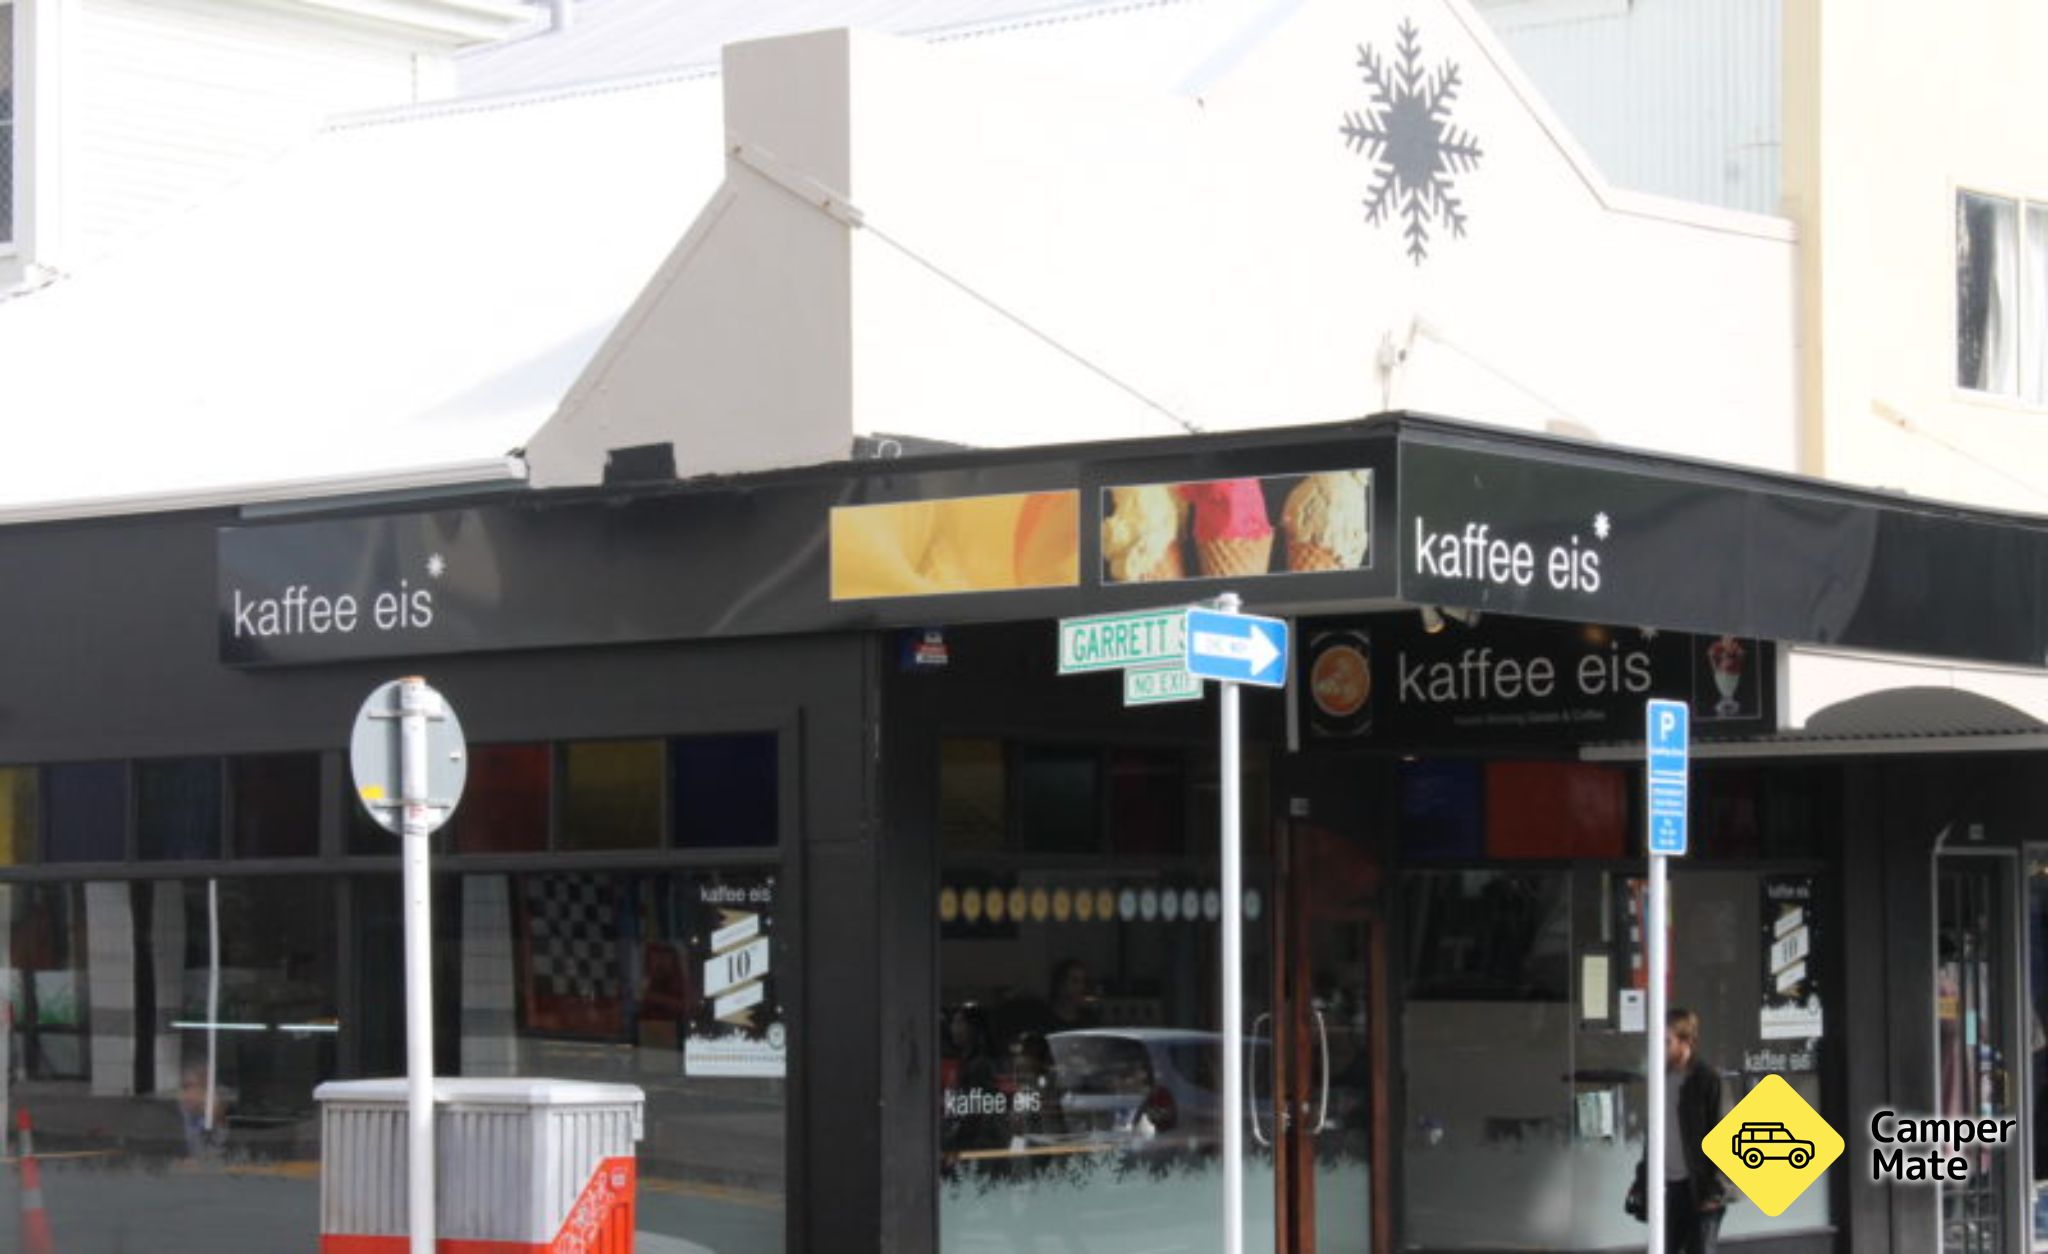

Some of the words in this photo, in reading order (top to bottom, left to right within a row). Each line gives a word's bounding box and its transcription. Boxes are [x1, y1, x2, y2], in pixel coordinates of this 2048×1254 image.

[1415, 516, 1534, 586] kaffee
[1548, 534, 1600, 592] eis
[233, 586, 357, 637] kaffee
[374, 581, 434, 630] eis
[1072, 619, 1168, 662] GARRETT
[1134, 675, 1155, 695] NO
[1399, 648, 1556, 703] kaffee
[1577, 641, 1652, 694] eis
[1660, 711, 1676, 742] P
[726, 949, 751, 984] 10
[943, 1087, 1007, 1117] kaffee
